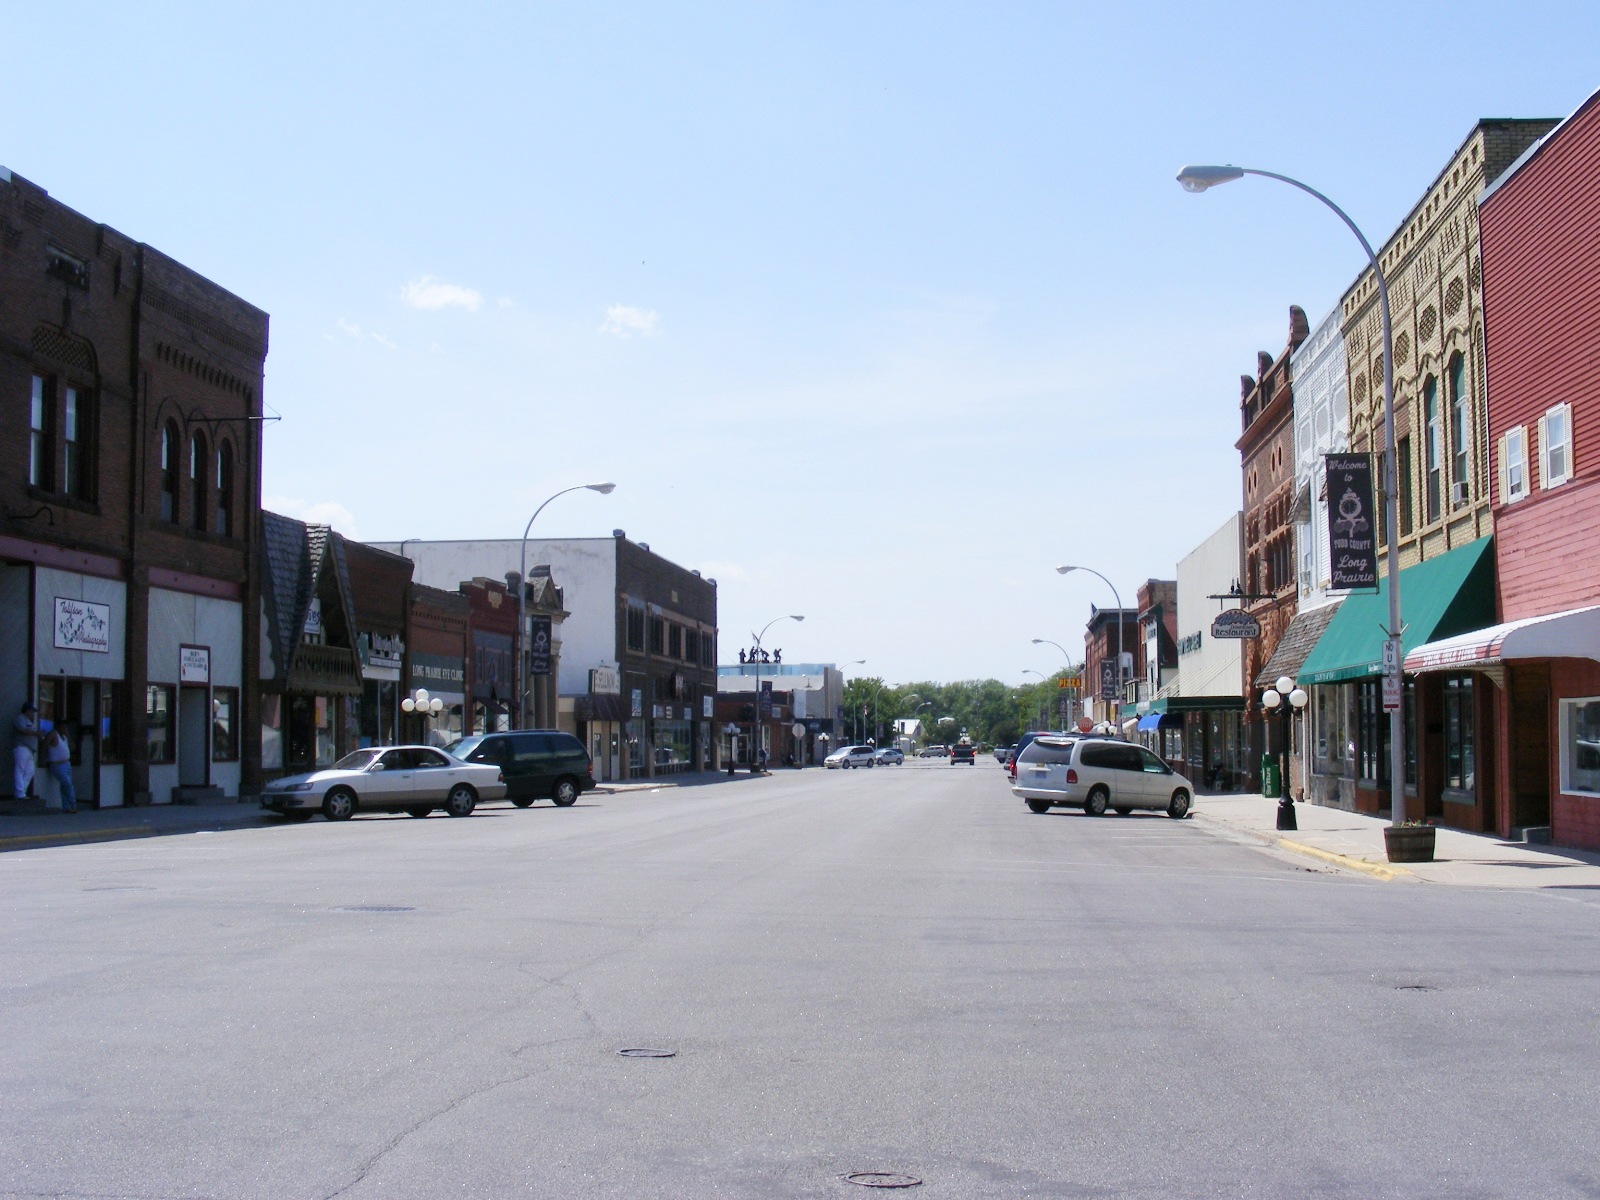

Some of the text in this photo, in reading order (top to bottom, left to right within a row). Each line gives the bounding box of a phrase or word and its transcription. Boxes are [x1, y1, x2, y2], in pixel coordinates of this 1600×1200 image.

[1328, 460, 1367, 470] Welcome
[1344, 473, 1353, 482] to
[1333, 538, 1371, 551] TODD COUNTY
[1337, 554, 1367, 570] Long
[1333, 571, 1374, 584] Prairie
[1215, 628, 1256, 636] Restaurant
[1387, 654, 1392, 662] U
[412, 664, 424, 677] LONG
[1060, 679, 1080, 687] PIZZA
